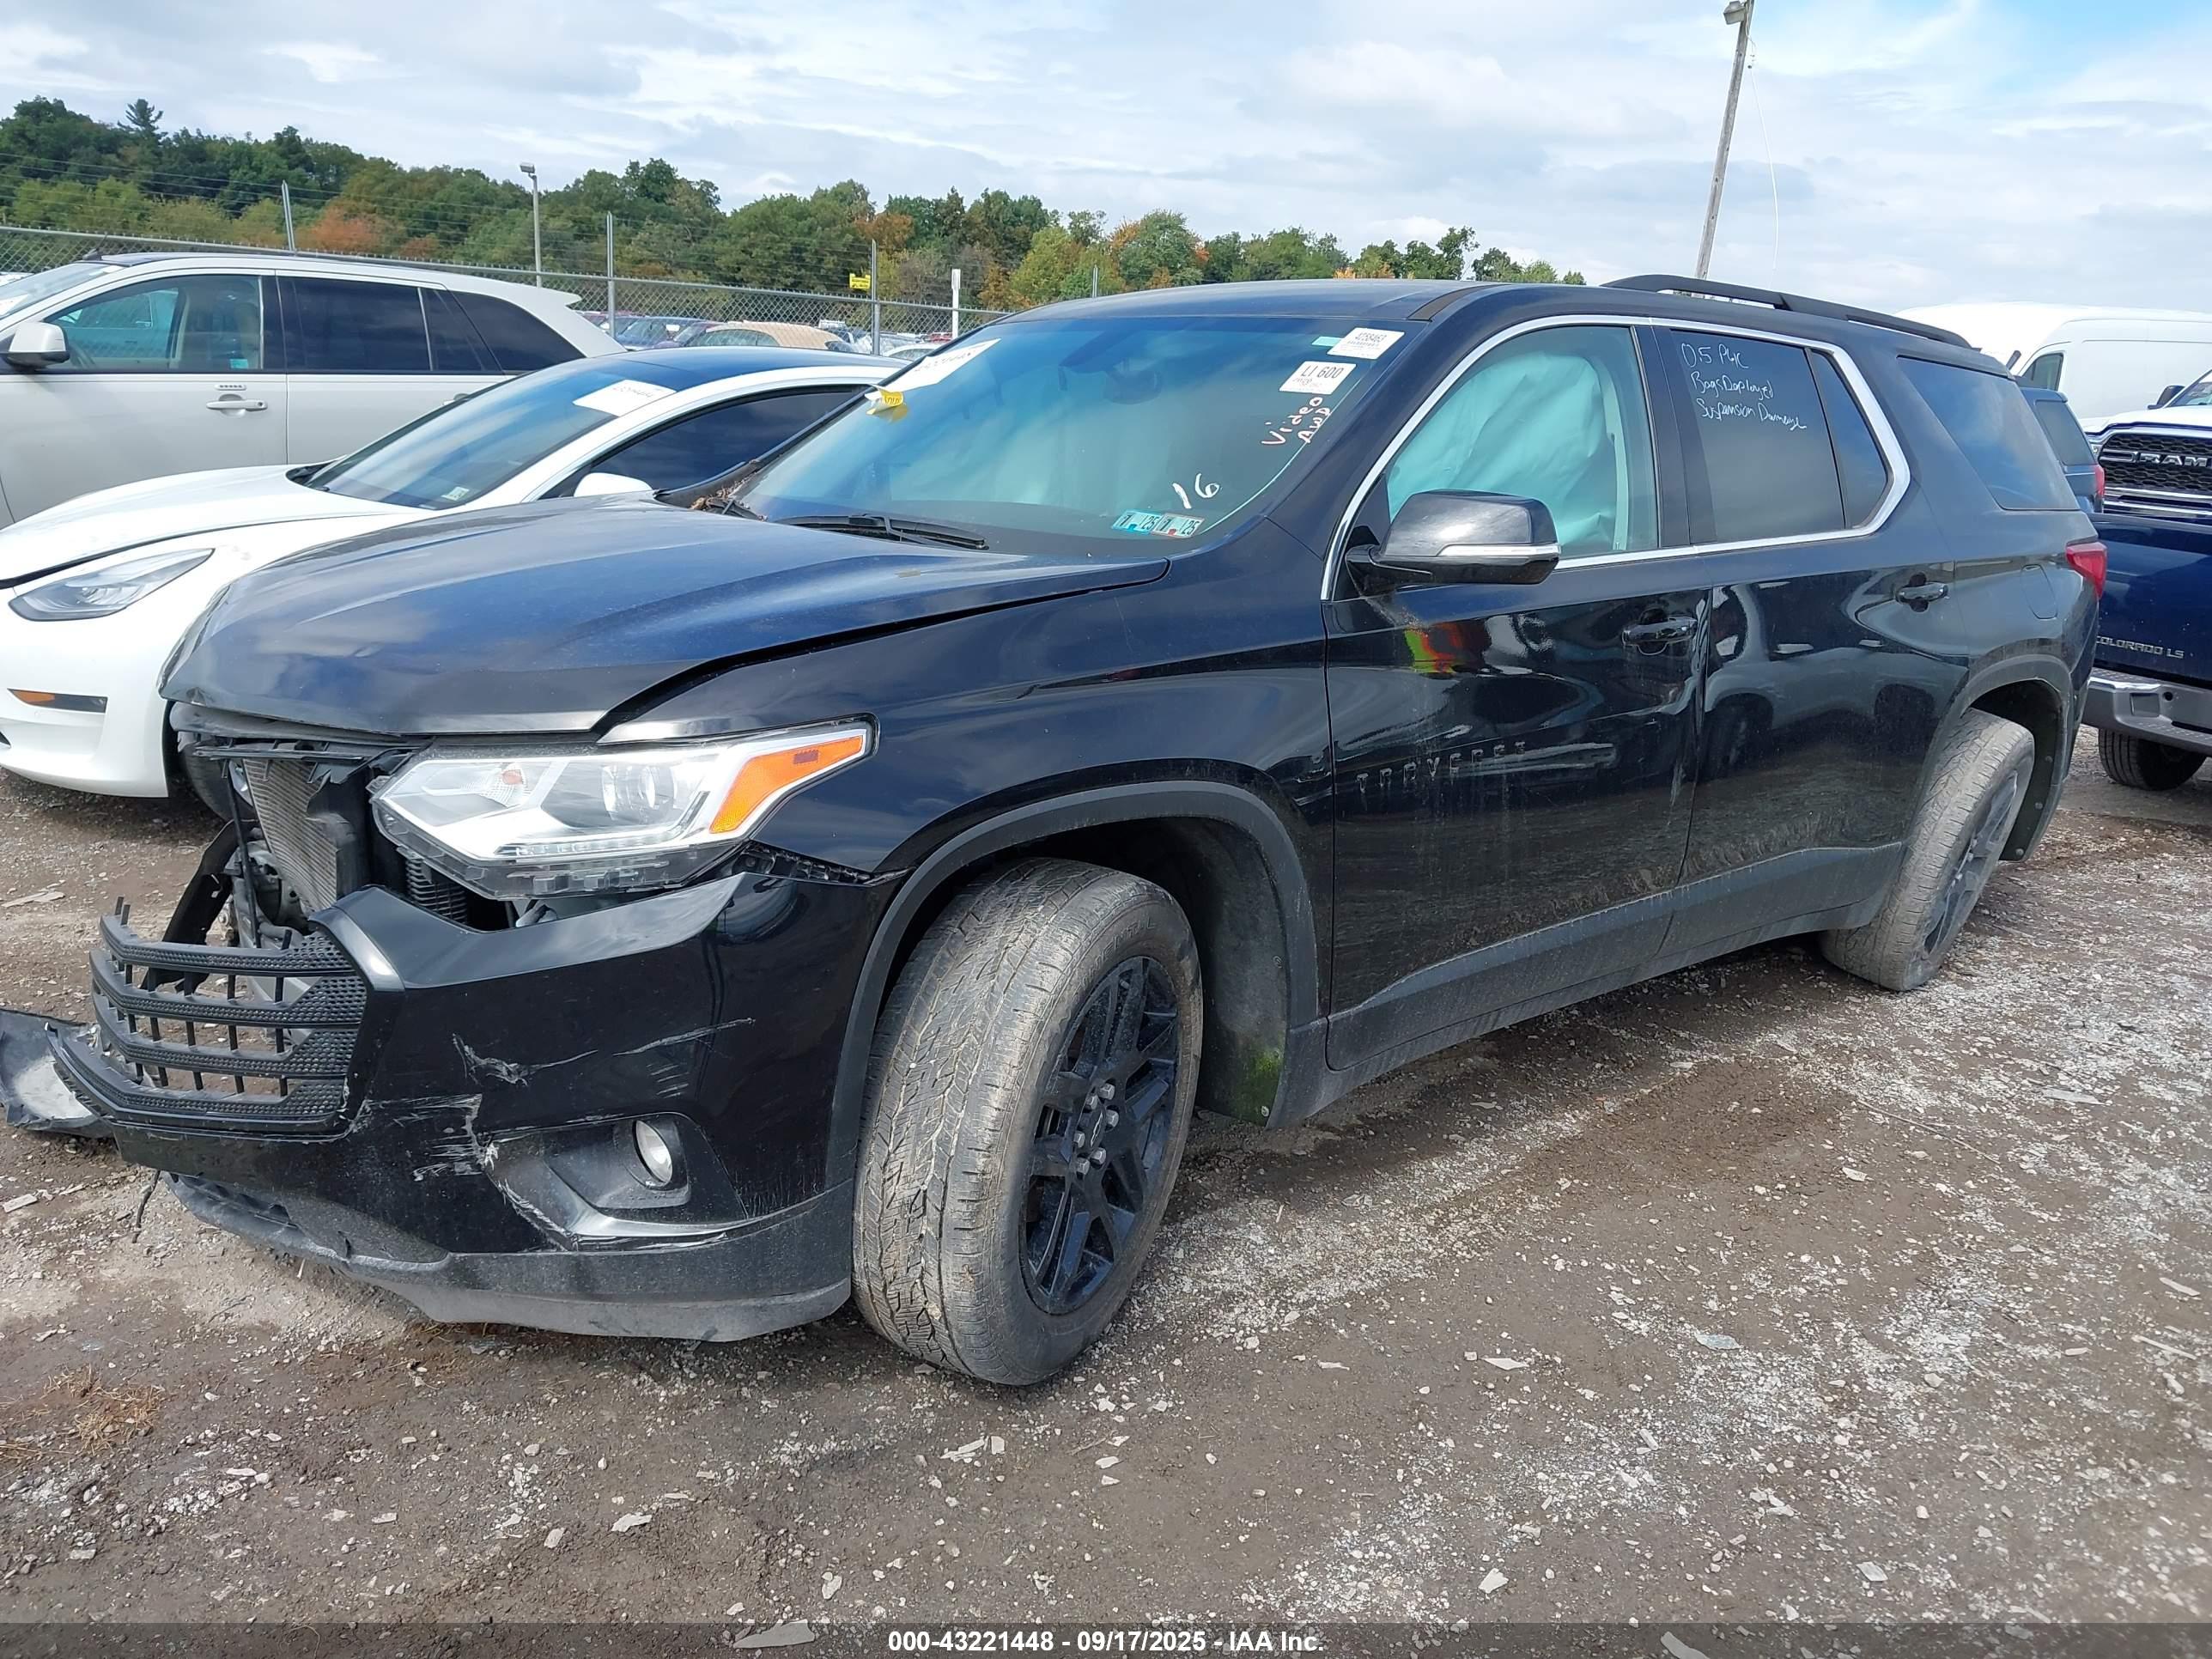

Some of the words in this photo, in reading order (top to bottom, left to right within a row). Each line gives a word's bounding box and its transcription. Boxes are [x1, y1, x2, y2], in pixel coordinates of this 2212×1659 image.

[1316, 367, 1344, 379] 600
[1261, 397, 1323, 445] Video
[2139, 452, 2208, 468] RAM
[1171, 472, 1220, 509] 16
[2166, 647, 2185, 659] LS
